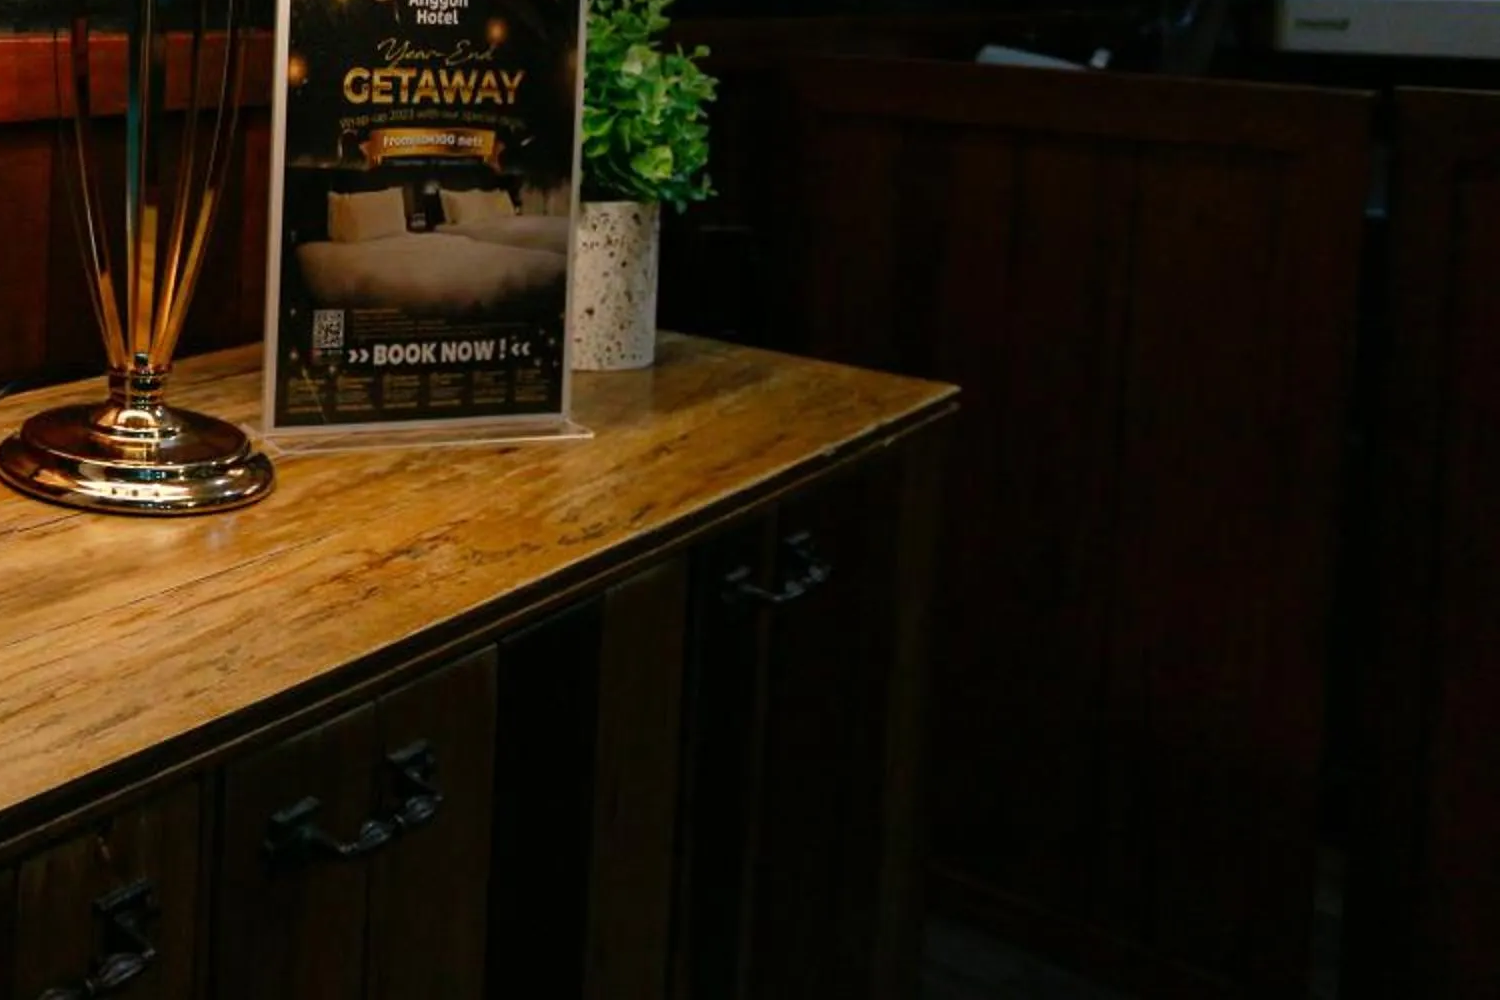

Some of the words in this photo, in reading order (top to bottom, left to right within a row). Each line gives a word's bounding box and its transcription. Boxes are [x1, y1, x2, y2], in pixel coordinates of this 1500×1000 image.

[416, 9, 459, 25] Hotel
[343, 66, 525, 105] GETAWAY
[373, 342, 436, 366] BOOK
